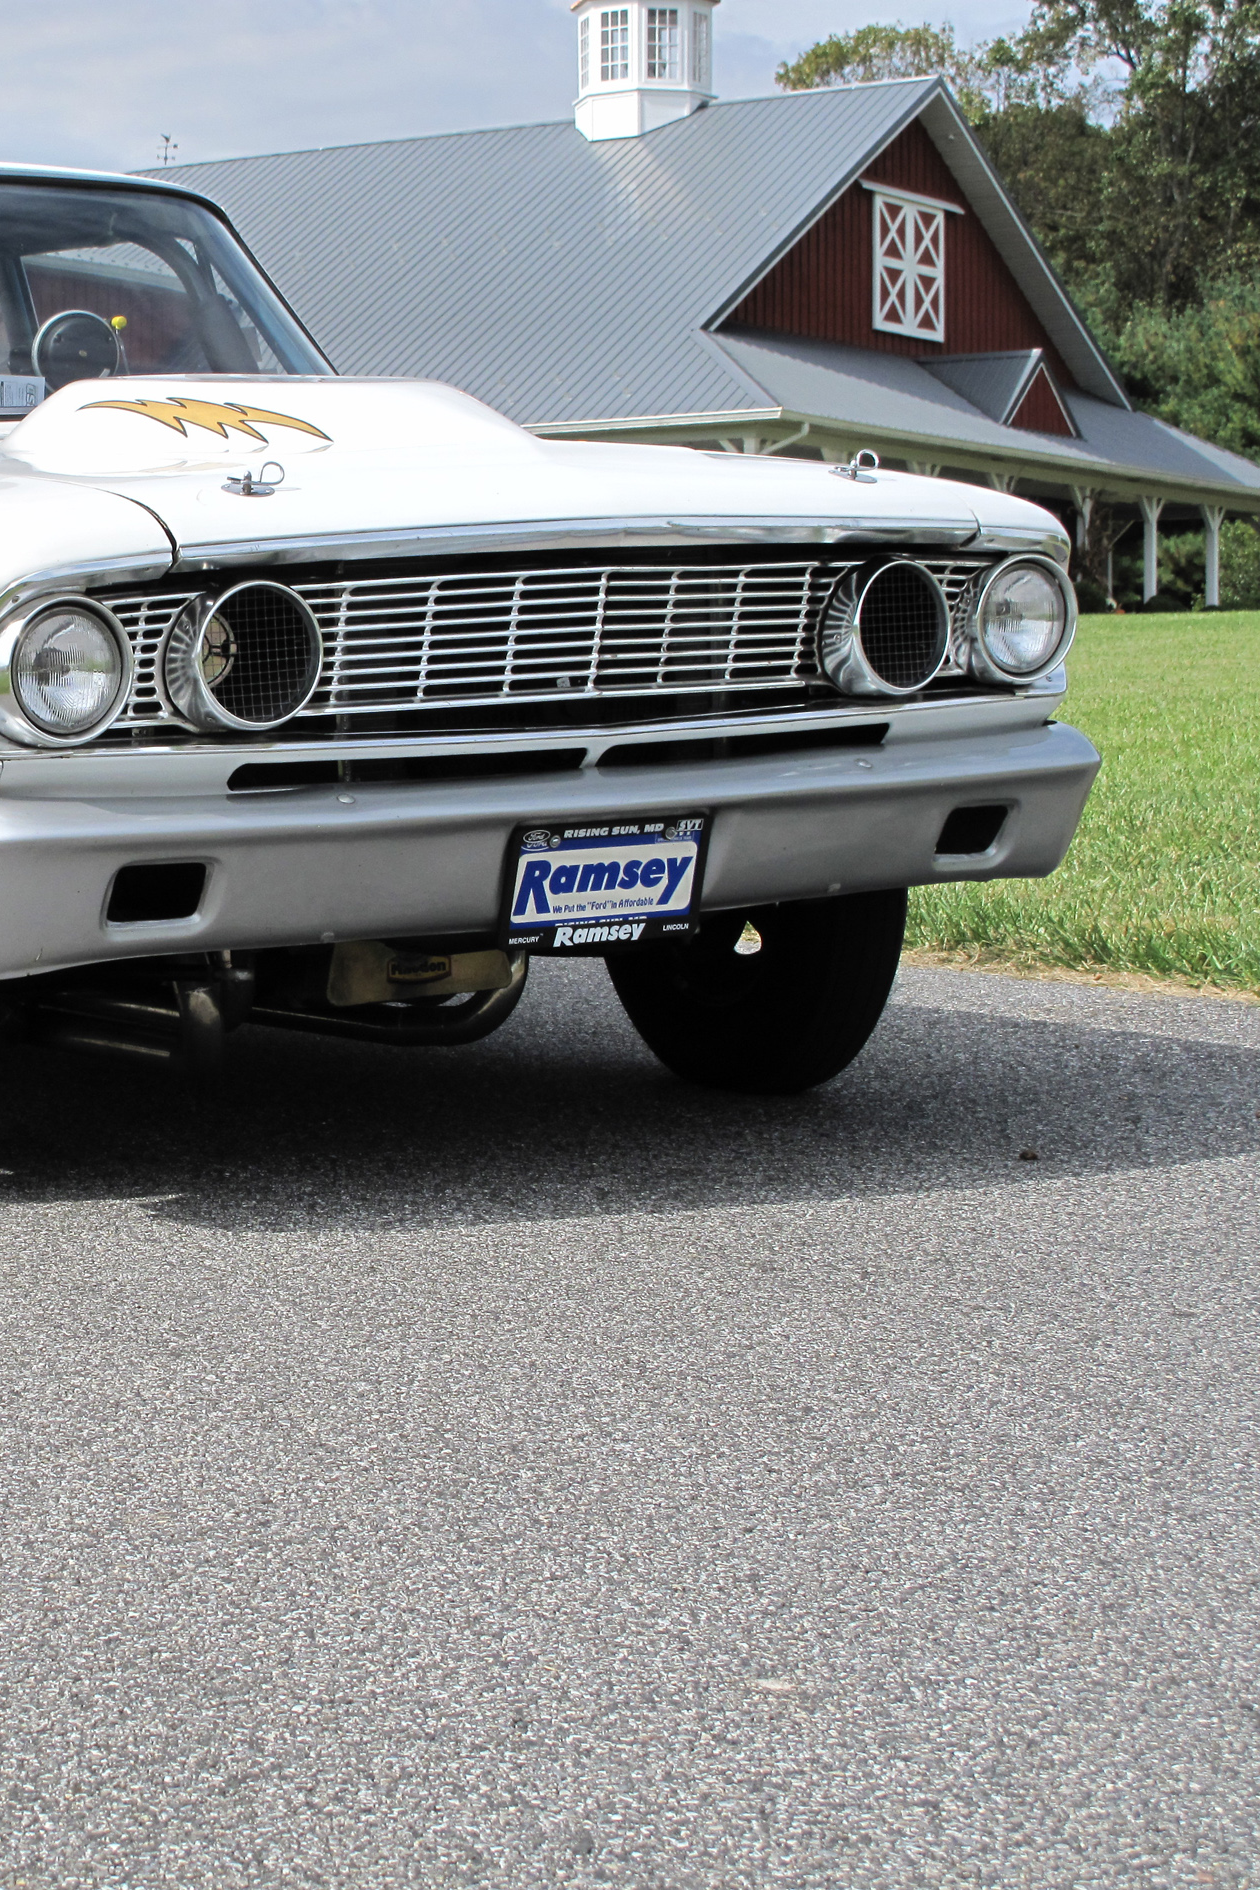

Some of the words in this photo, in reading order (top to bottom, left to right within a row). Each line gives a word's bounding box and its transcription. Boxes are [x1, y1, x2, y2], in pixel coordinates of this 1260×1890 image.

[563, 828, 608, 839] RISING
[612, 825, 640, 836] SUN,
[644, 823, 664, 833] MD
[678, 819, 703, 831] SVT
[513, 856, 694, 916] Ramsey
[552, 905, 563, 914] We
[563, 904, 575, 912] Put
[576, 903, 586, 911] the
[618, 897, 654, 908] Affordable
[553, 922, 646, 947] Ramsey
[662, 923, 689, 932] LINCOLN
